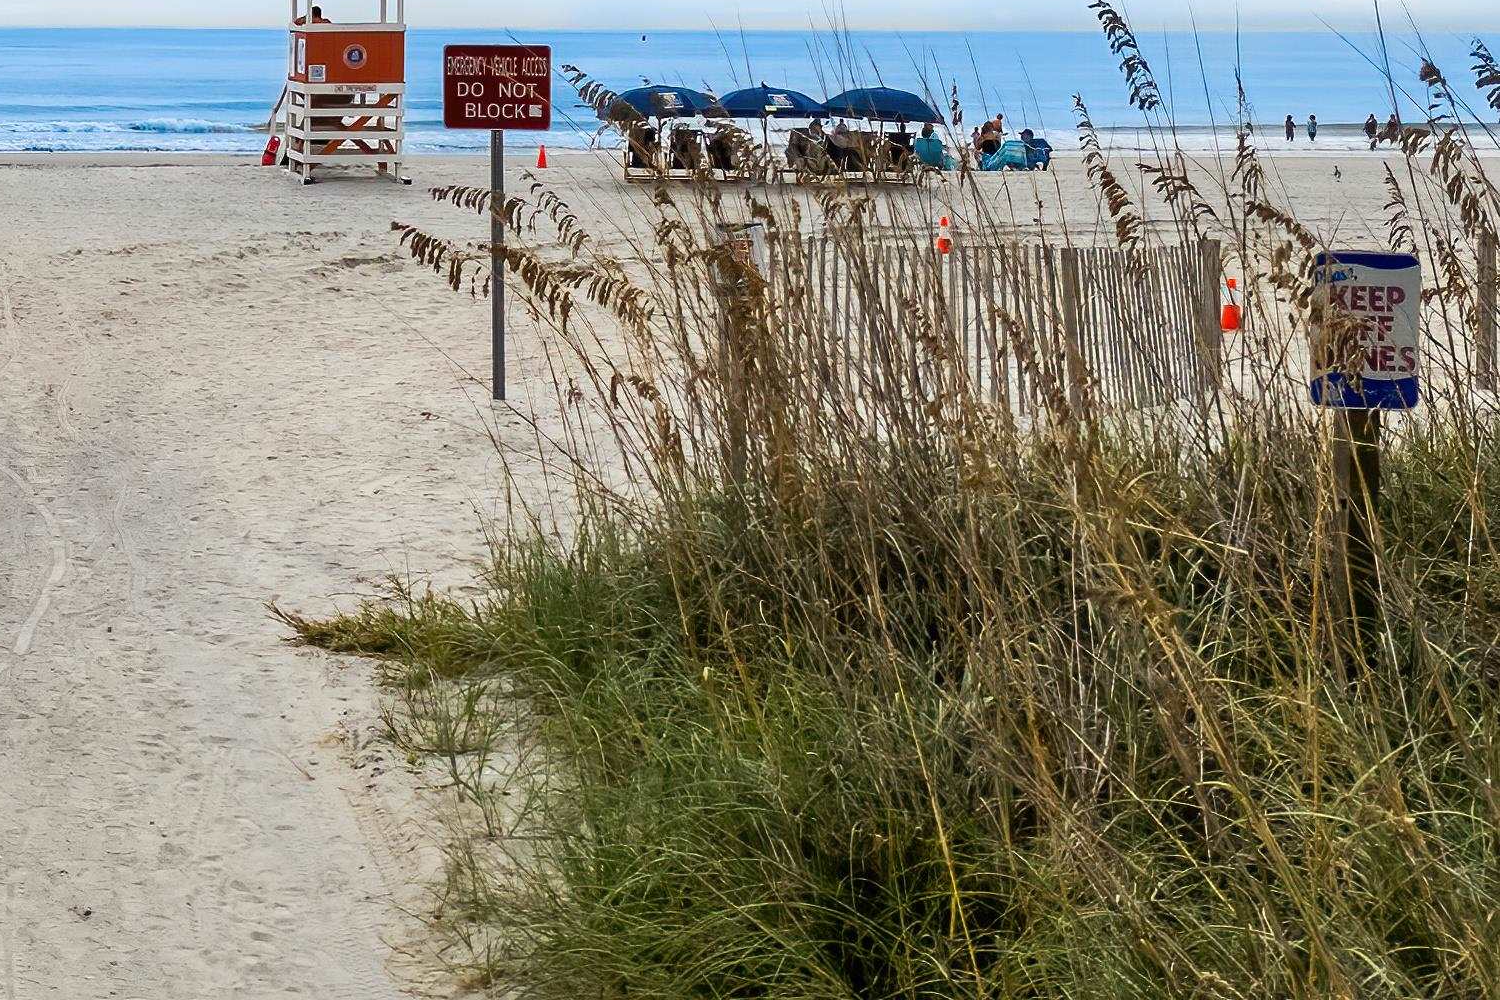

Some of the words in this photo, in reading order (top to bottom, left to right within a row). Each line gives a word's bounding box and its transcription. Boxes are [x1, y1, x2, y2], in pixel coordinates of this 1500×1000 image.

[447, 56, 487, 76] EMERGENCY
[522, 55, 548, 76] ACCESS
[457, 82, 484, 97] DO
[499, 82, 538, 98] NOT
[465, 102, 526, 119] BLOCK
[1329, 285, 1406, 313] KEEP
